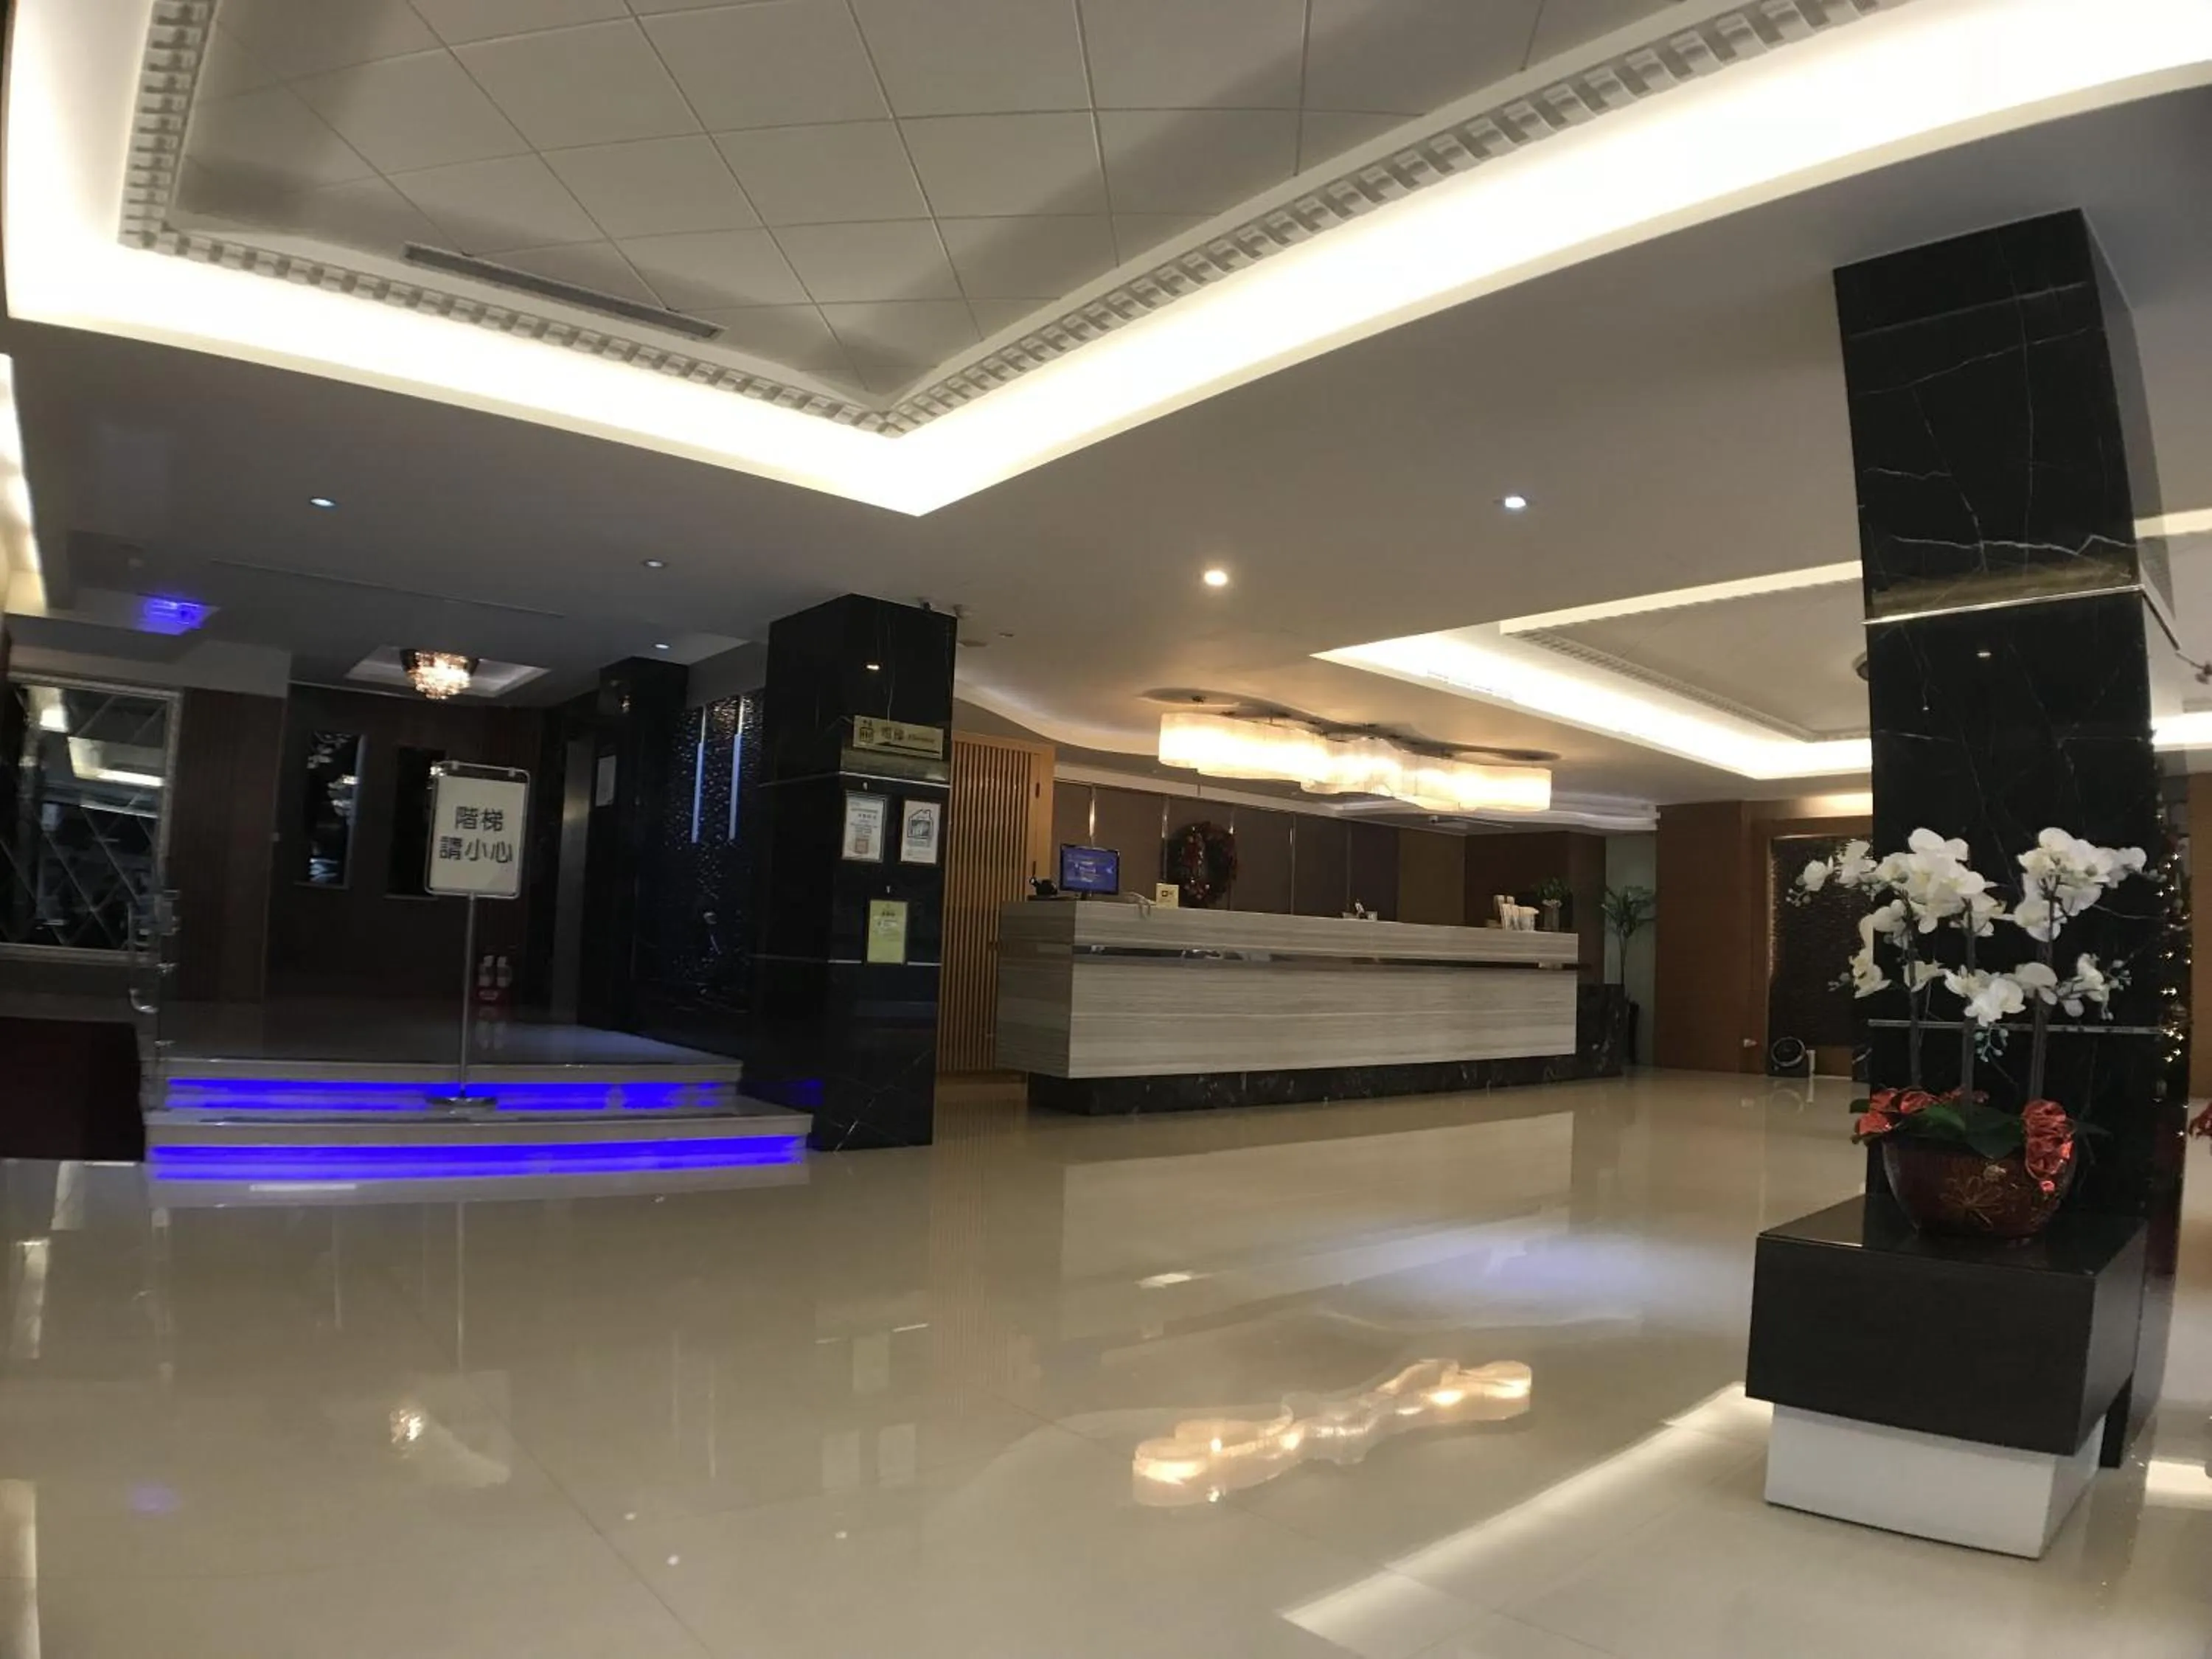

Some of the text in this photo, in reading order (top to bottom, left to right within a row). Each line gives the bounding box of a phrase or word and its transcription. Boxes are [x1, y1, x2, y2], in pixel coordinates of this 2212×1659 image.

[455, 806, 504, 832] 階梯
[439, 835, 513, 863] 請小心
